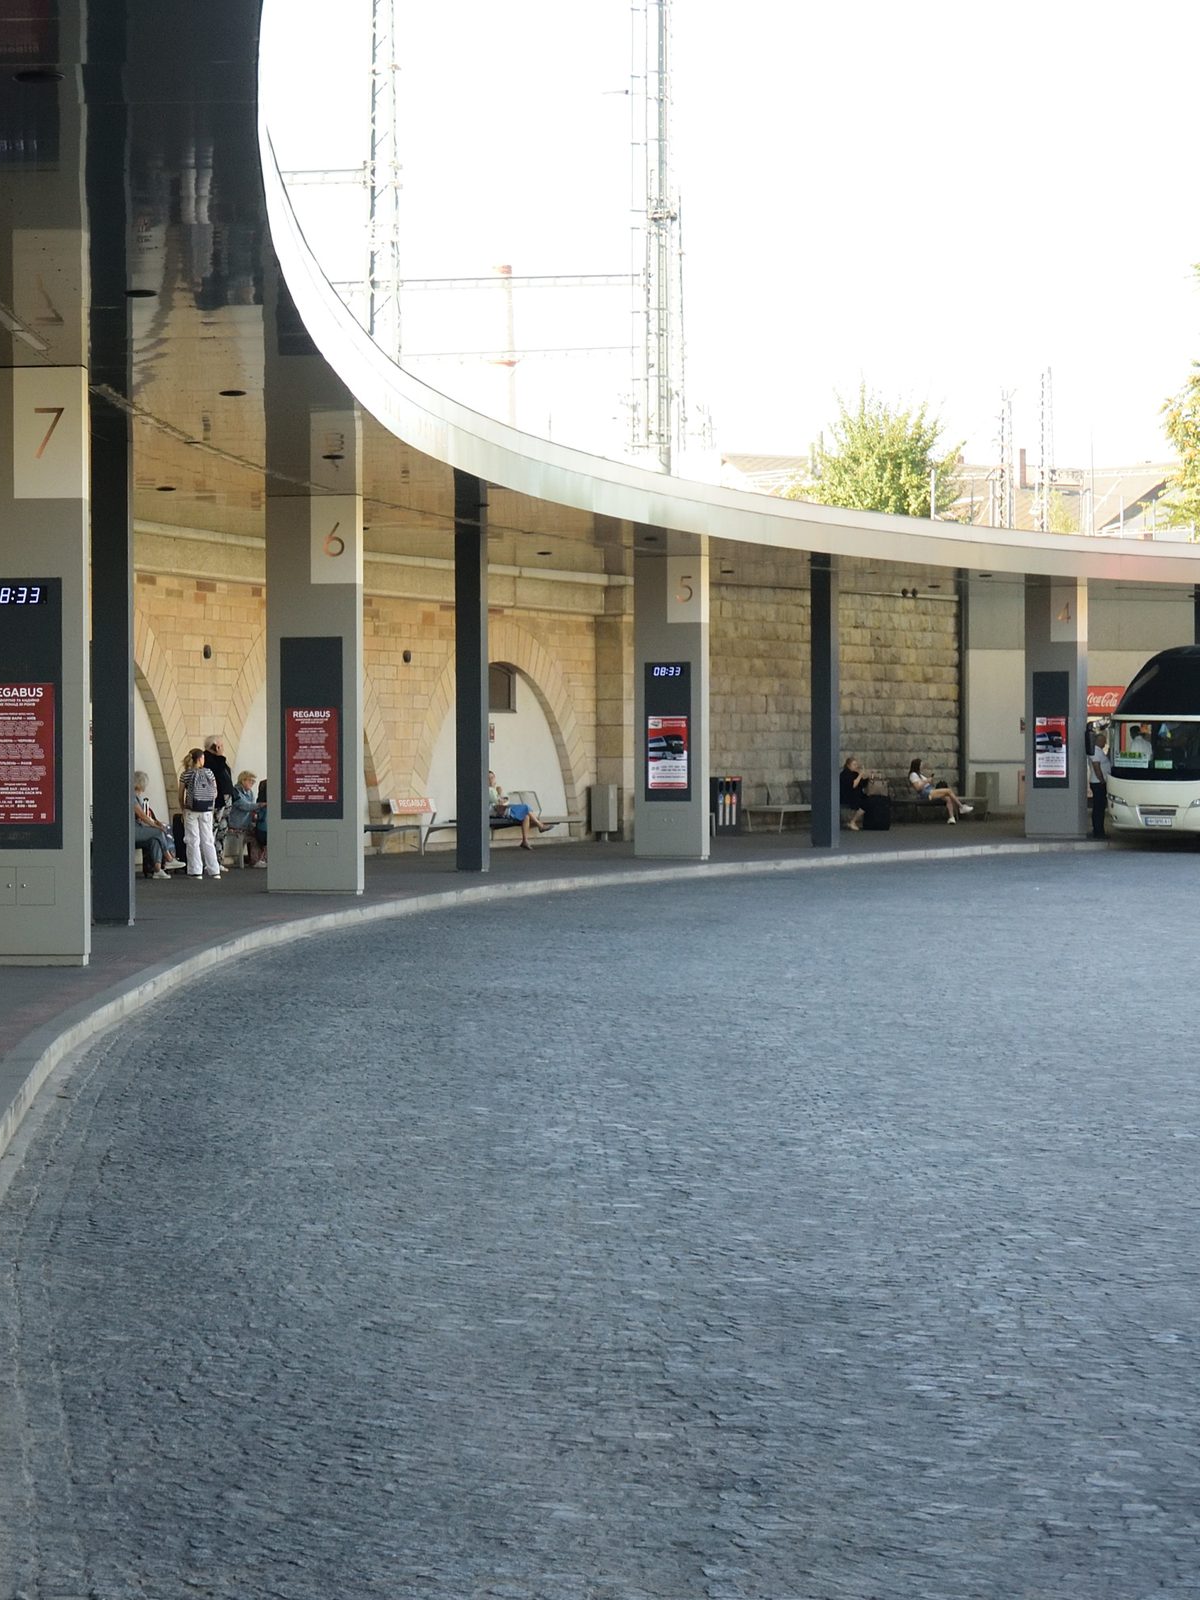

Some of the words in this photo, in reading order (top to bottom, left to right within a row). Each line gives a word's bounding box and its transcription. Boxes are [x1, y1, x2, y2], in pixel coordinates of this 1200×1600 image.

[34, 407, 65, 459] 7
[322, 522, 345, 557] 6
[676, 576, 693, 603] 5
[1057, 602, 1071, 623] 4
[653, 667, 680, 676] 08:33
